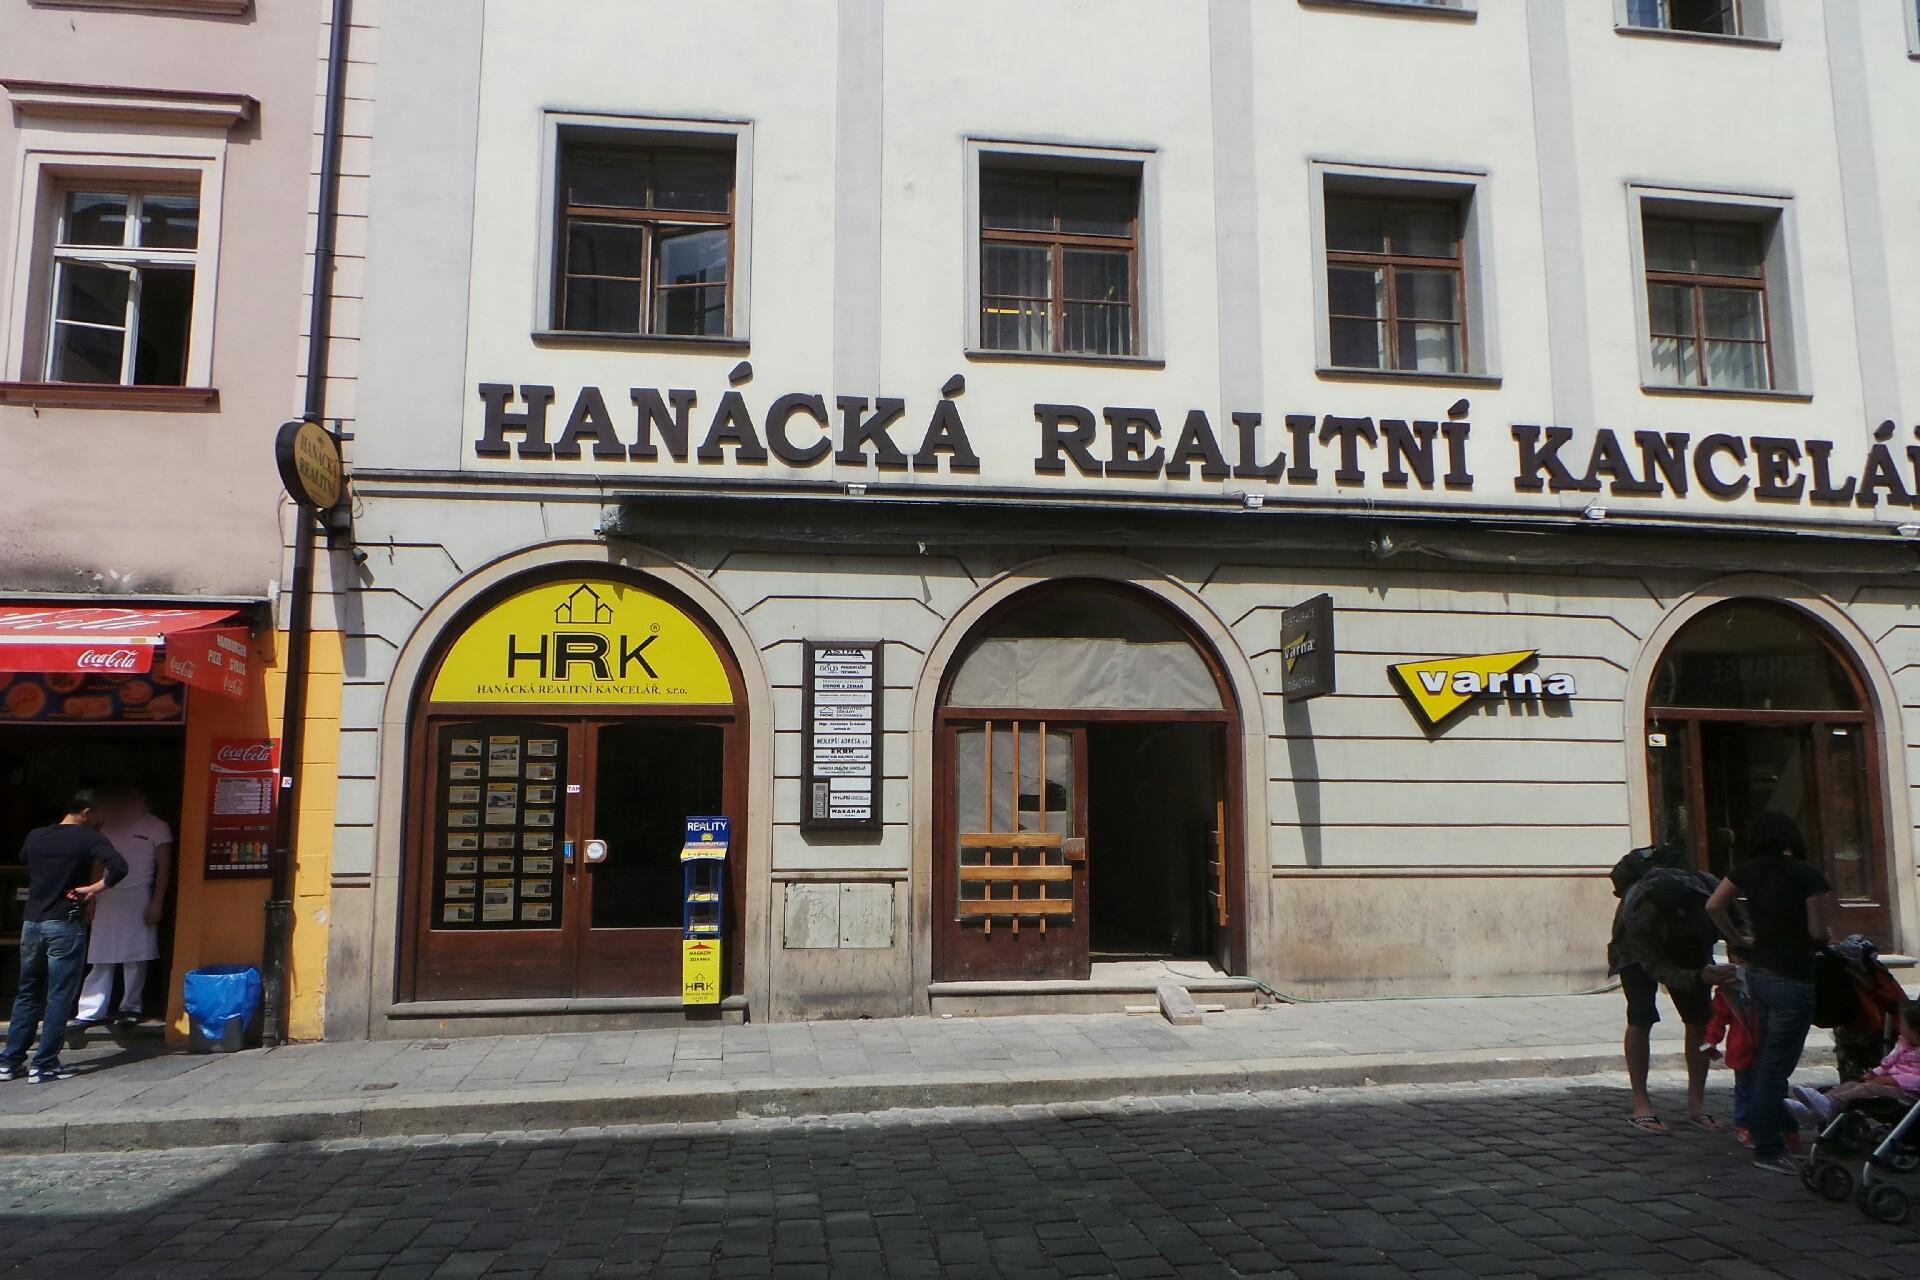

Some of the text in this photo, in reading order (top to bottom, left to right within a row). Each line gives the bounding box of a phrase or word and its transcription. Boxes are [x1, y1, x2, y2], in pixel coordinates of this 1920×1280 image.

[475, 360, 1920, 510] HANÁCKÁ REALITNÍ KANCELÁ
[507, 631, 659, 682] HRK
[1283, 639, 1316, 660] varna
[476, 683, 535, 695] HANÁCKÁ
[538, 683, 592, 695] REALITNÍ
[666, 687, 688, 695] s.r.o.
[1416, 669, 1577, 696] varna
[687, 822, 727, 832] REALITY
[685, 981, 714, 991] HRK
